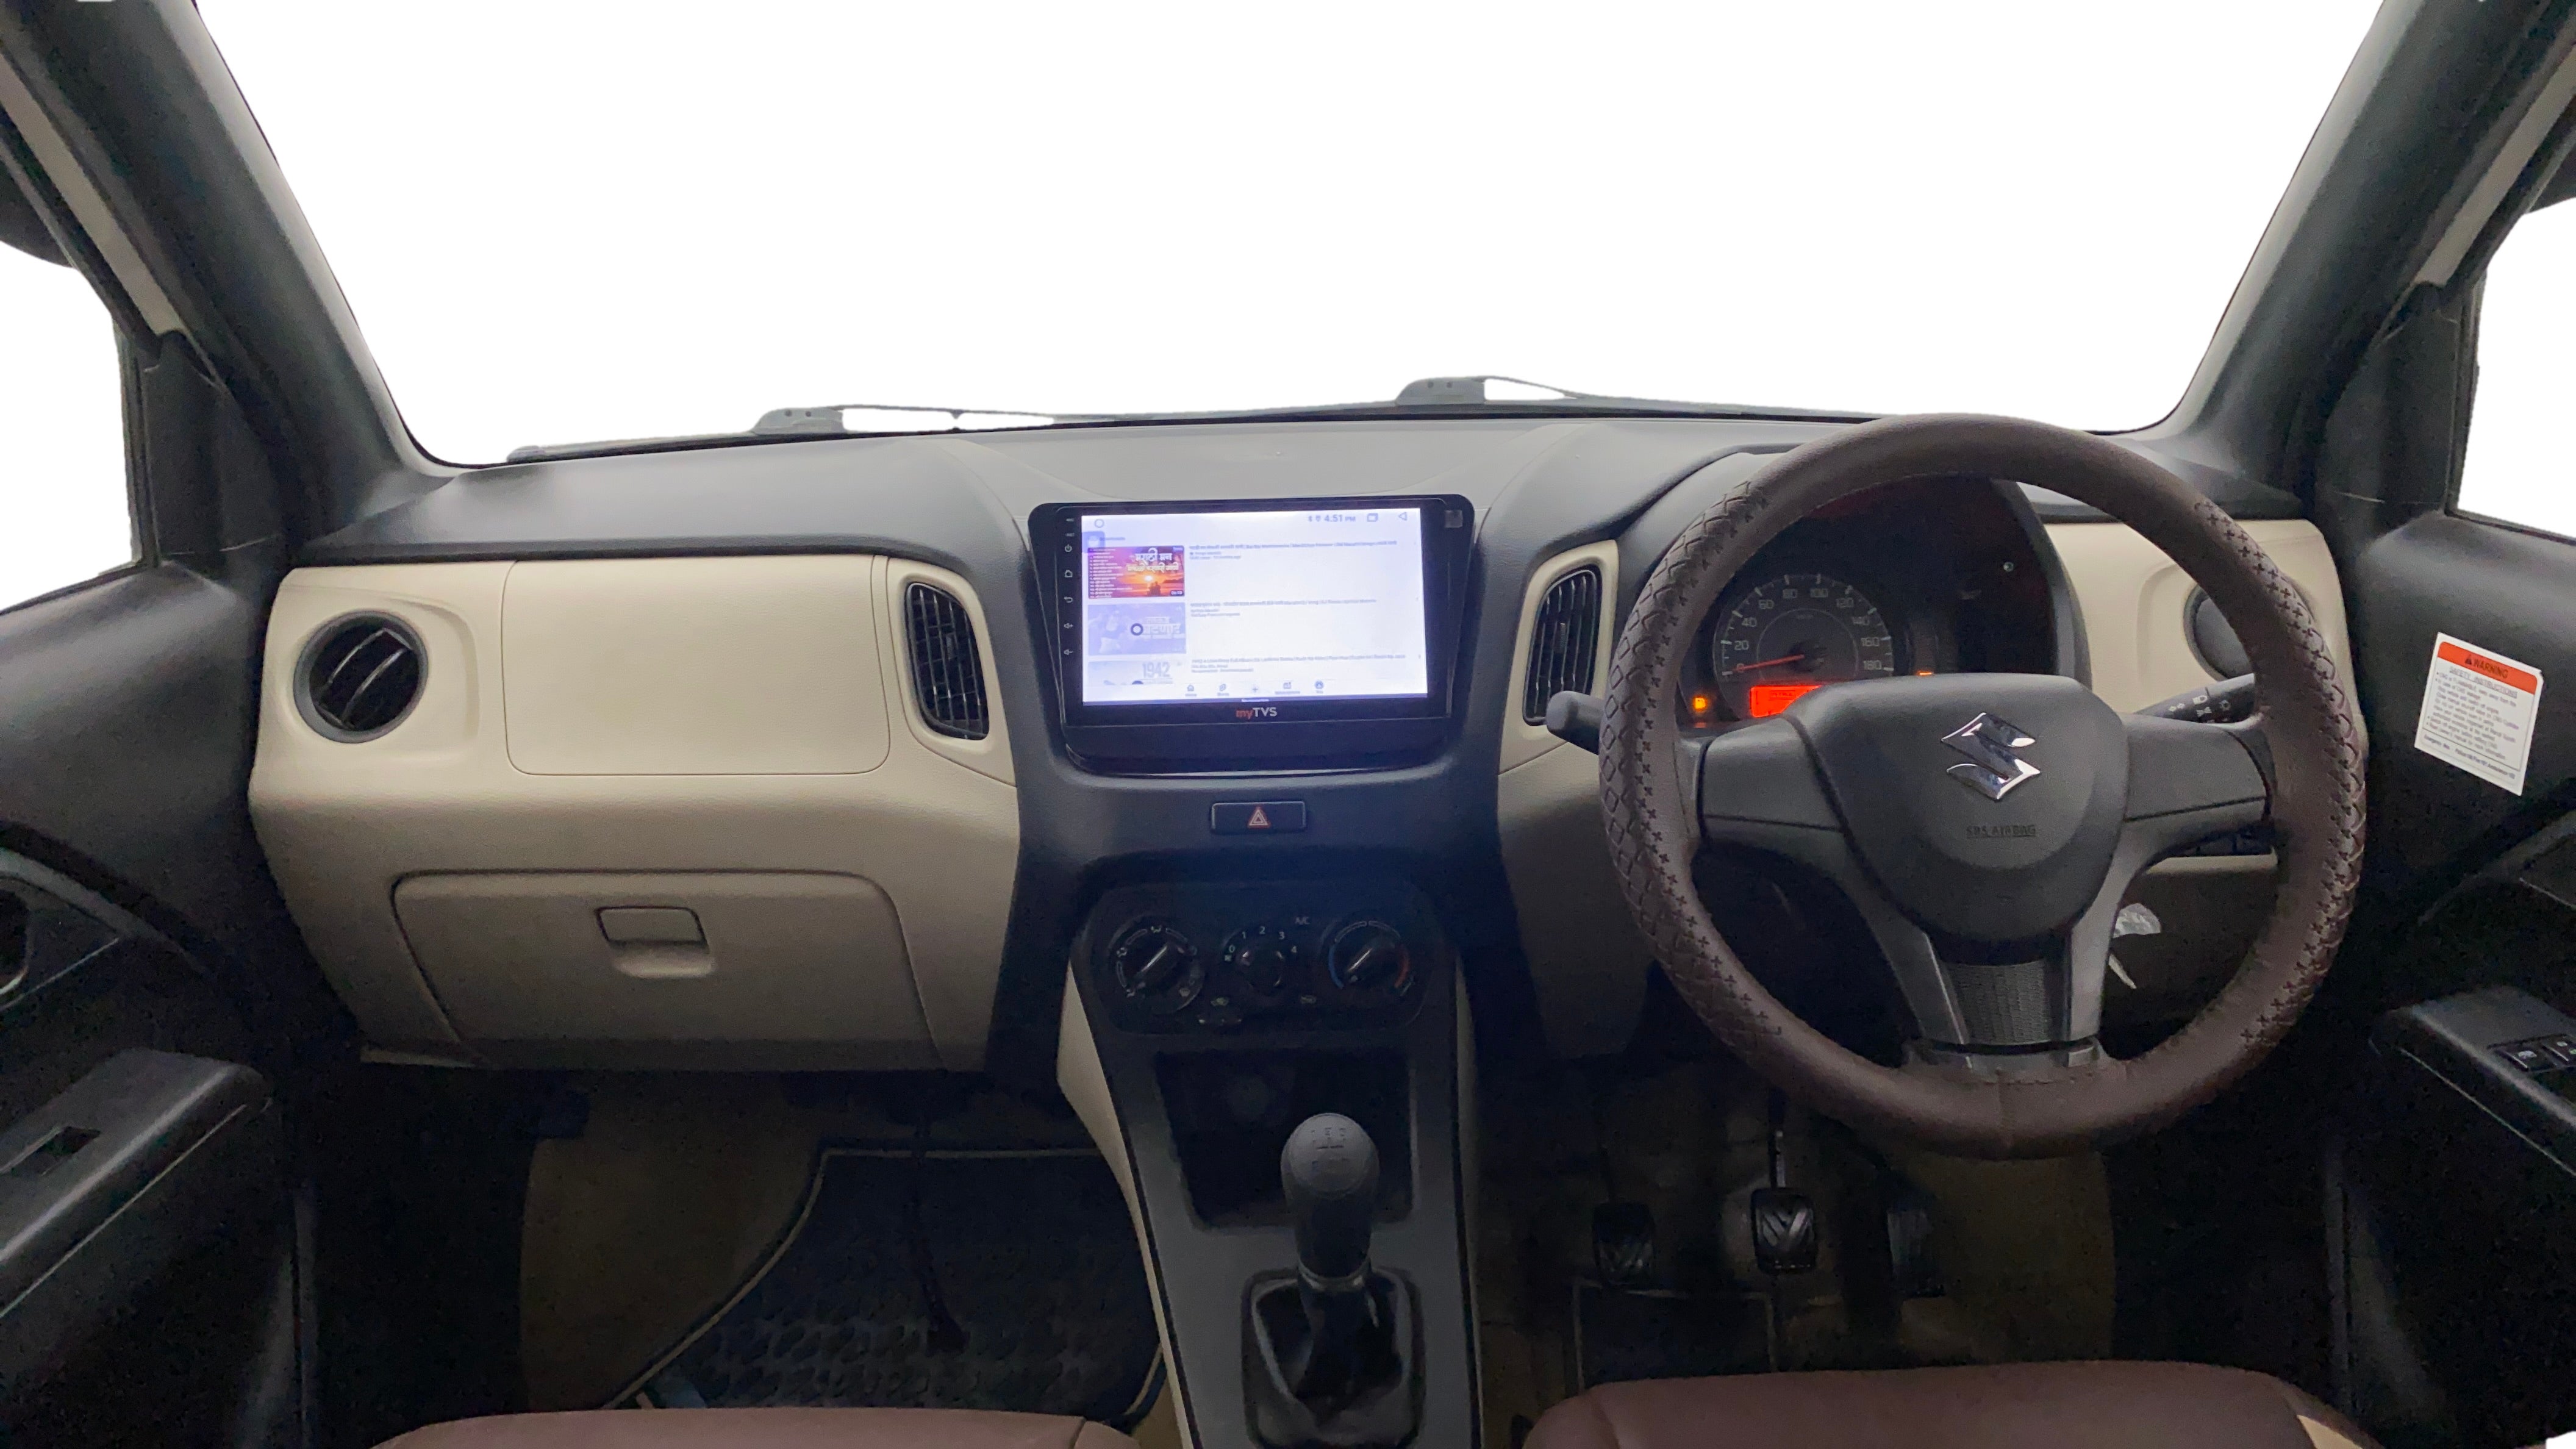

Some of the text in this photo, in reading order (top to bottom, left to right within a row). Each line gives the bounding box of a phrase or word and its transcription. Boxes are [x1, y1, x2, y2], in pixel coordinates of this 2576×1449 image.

[1783, 589, 1798, 598] 80
[1759, 599, 1775, 609] 60
[1836, 598, 1855, 608] 120
[1742, 617, 1758, 628] 40
[1852, 616, 1870, 626] 140
[1734, 640, 1749, 651] 20
[1861, 637, 1880, 646] 160
[1864, 659, 1882, 670] 180
[2474, 659, 2509, 679] WARNING
[1142, 662, 1170, 678] 1942
[1236, 707, 1278, 720] myTVS
[1259, 926, 1265, 935] 2
[1278, 931, 1286, 940] 3
